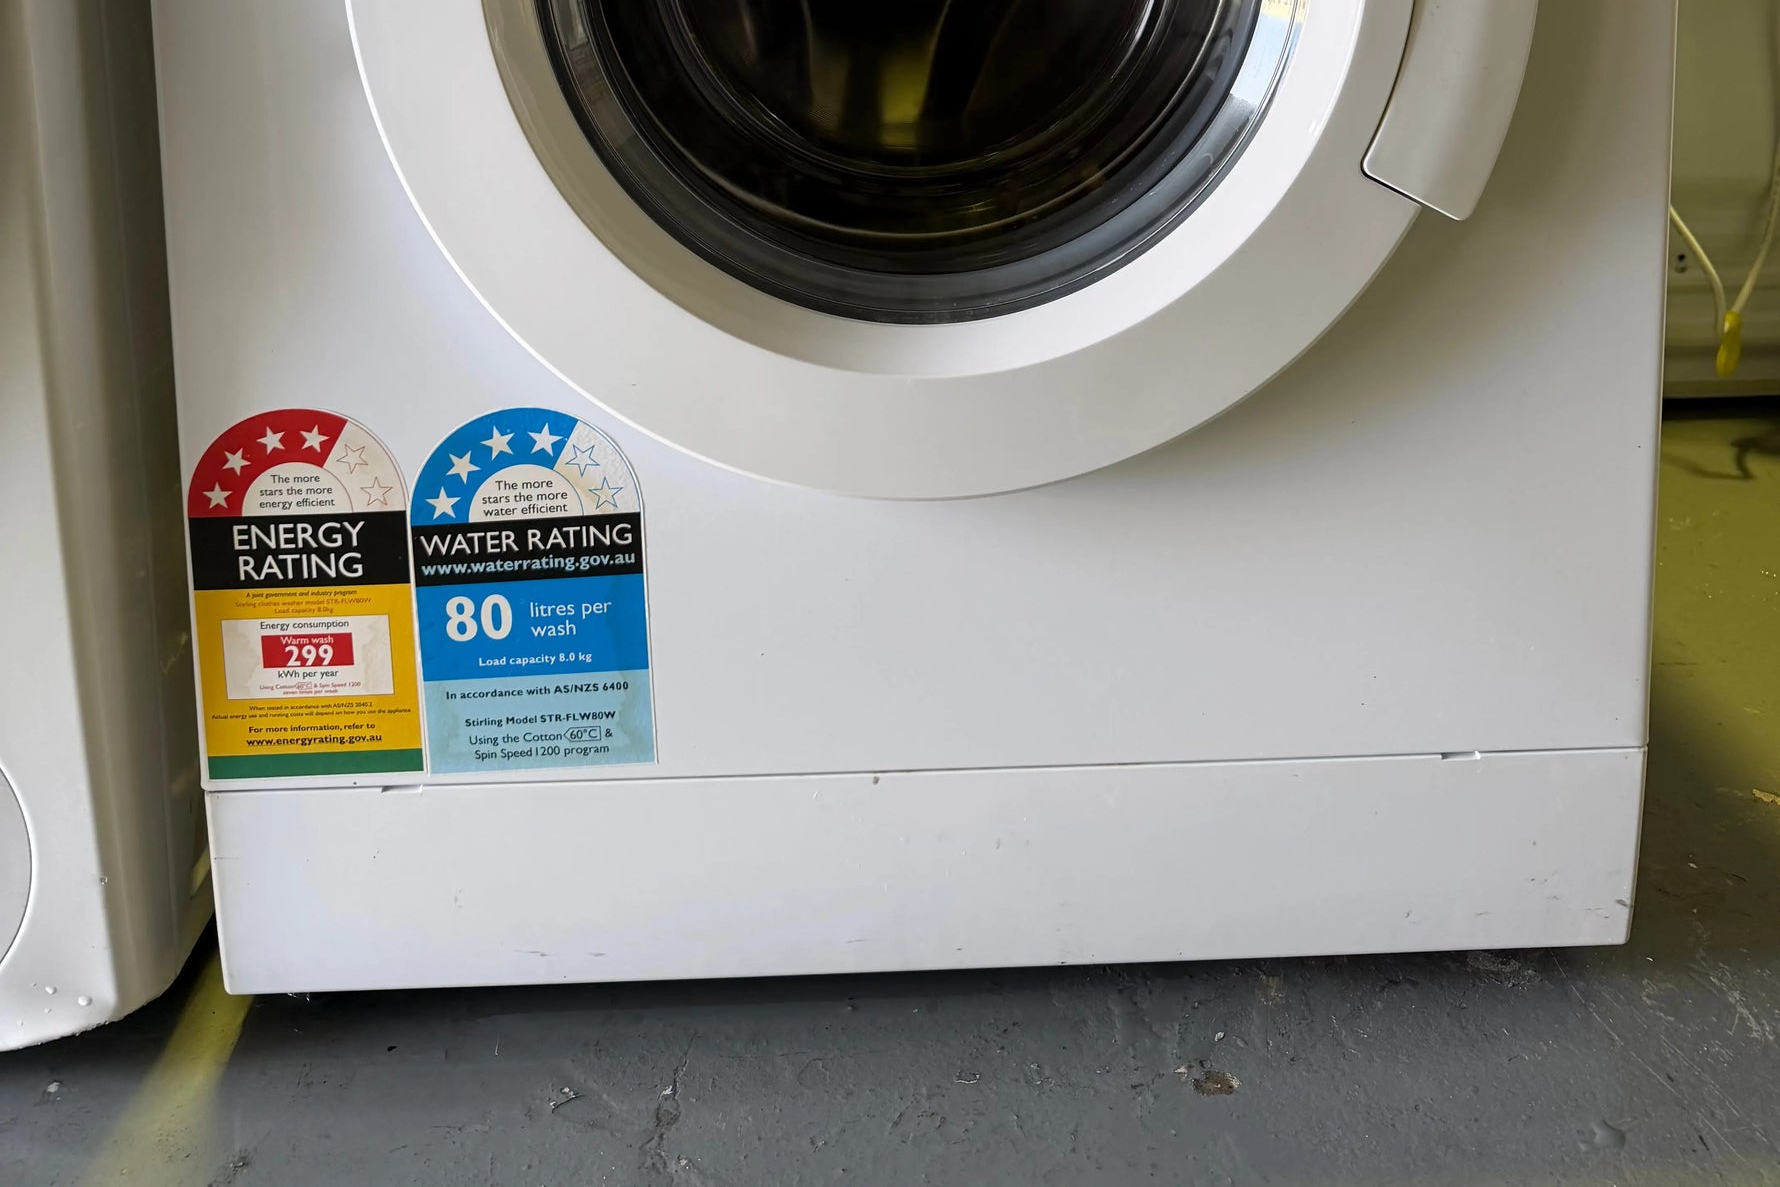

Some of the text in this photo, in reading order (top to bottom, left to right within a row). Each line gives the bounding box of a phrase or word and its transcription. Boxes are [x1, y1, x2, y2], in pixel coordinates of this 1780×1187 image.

[271, 474, 320, 484] The more
[495, 480, 553, 491] The more
[260, 486, 332, 496] stars the more
[482, 491, 568, 504] stars the more
[260, 498, 335, 510] energy efficient
[483, 503, 568, 517] water efficient
[233, 521, 365, 550] ENERGY
[420, 523, 633, 557] WATER RATING
[239, 553, 363, 581] RATING
[421, 553, 635, 576] www.waterrating.gov.au
[530, 601, 611, 619] litres per
[446, 594, 513, 642] 80
[260, 620, 349, 631] Energy consumption
[531, 620, 576, 637] wash
[280, 636, 334, 645] Warm wash
[284, 645, 334, 667] 299
[479, 653, 593, 667] Load capacity 8.0 kg
[278, 670, 339, 680] kWh per year
[446, 681, 629, 700] In accordance with AS/NZS 6400
[465, 711, 616, 727] Stirling Model STR-FLW80W
[246, 734, 382, 746] www.energyrating.gov.au
[469, 735, 499, 746] Using
[502, 734, 519, 743] the
[523, 732, 563, 742] Cotton
[605, 729, 613, 738] &
[475, 746, 609, 760] Spin Speed 1200 program
